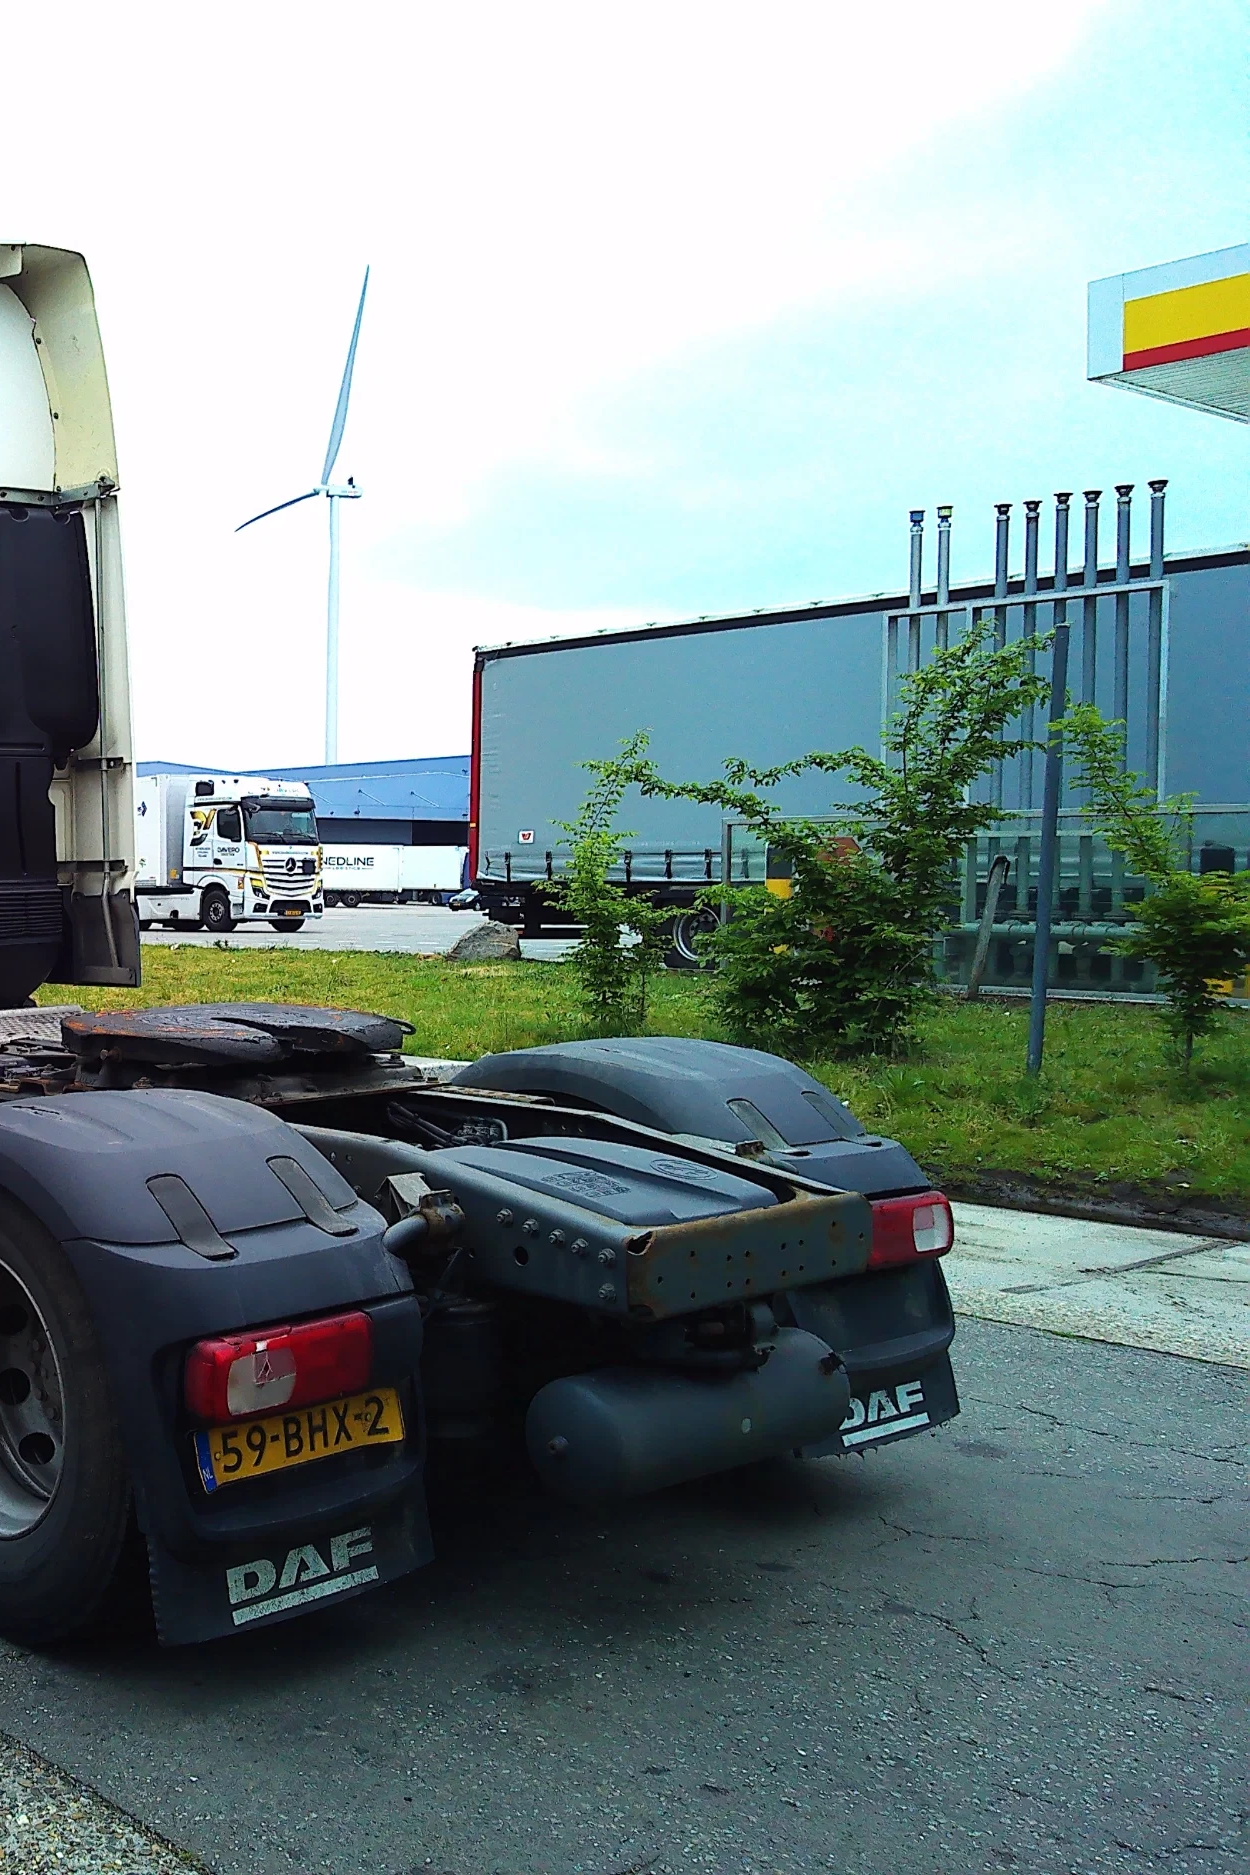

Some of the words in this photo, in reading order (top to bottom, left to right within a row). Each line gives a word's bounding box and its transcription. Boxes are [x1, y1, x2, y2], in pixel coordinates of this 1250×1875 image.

[202, 1465, 214, 1482] NL
[221, 1395, 390, 1474] 59-BHX-2
[226, 1526, 374, 1605] DAF
